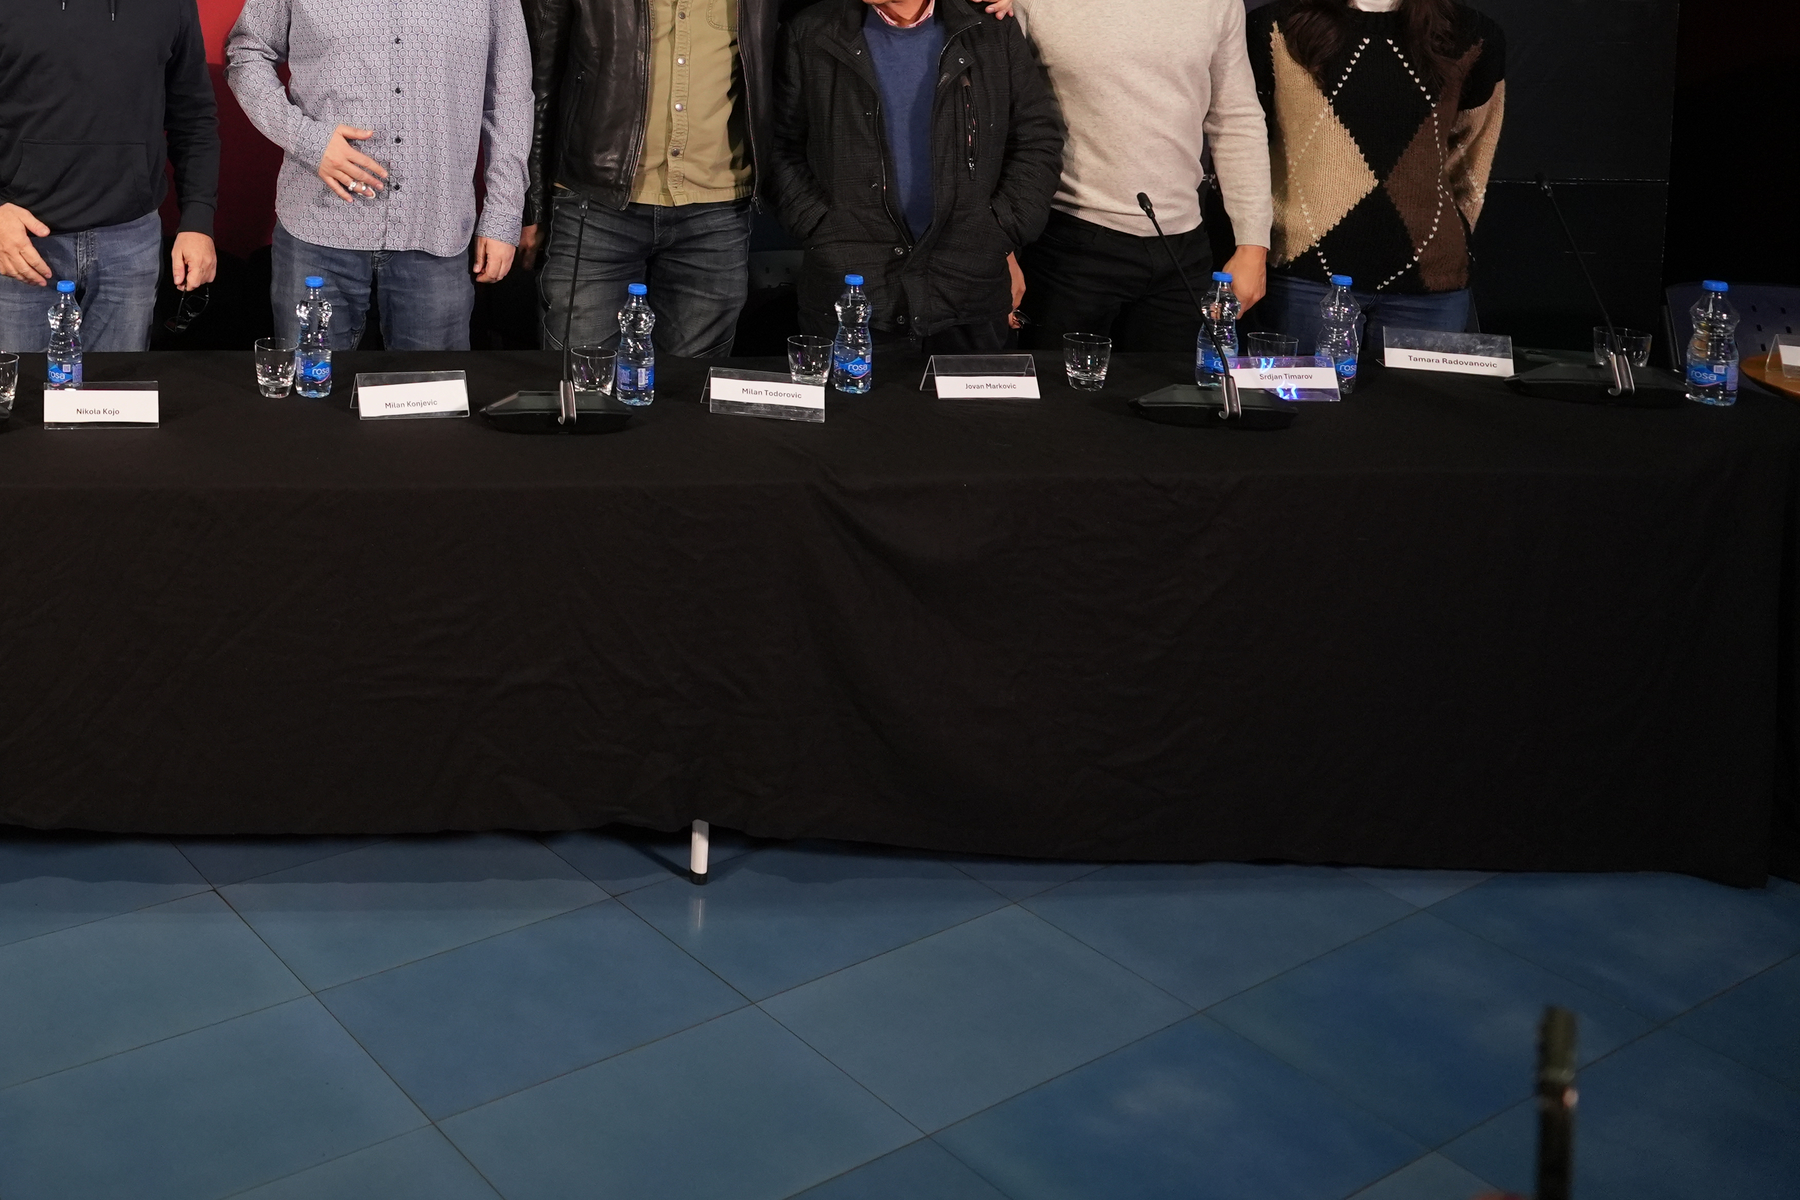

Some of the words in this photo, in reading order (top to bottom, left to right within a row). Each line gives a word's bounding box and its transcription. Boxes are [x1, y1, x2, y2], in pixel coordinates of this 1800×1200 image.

[1408, 355, 1440, 364] Tamara
[1442, 358, 1497, 368] Radovanovic
[848, 363, 868, 371] rosa
[49, 370, 65, 380] rosa
[1691, 370, 1717, 380] rosa
[764, 389, 802, 398] Todorovic
[102, 408, 120, 416] Kojo
